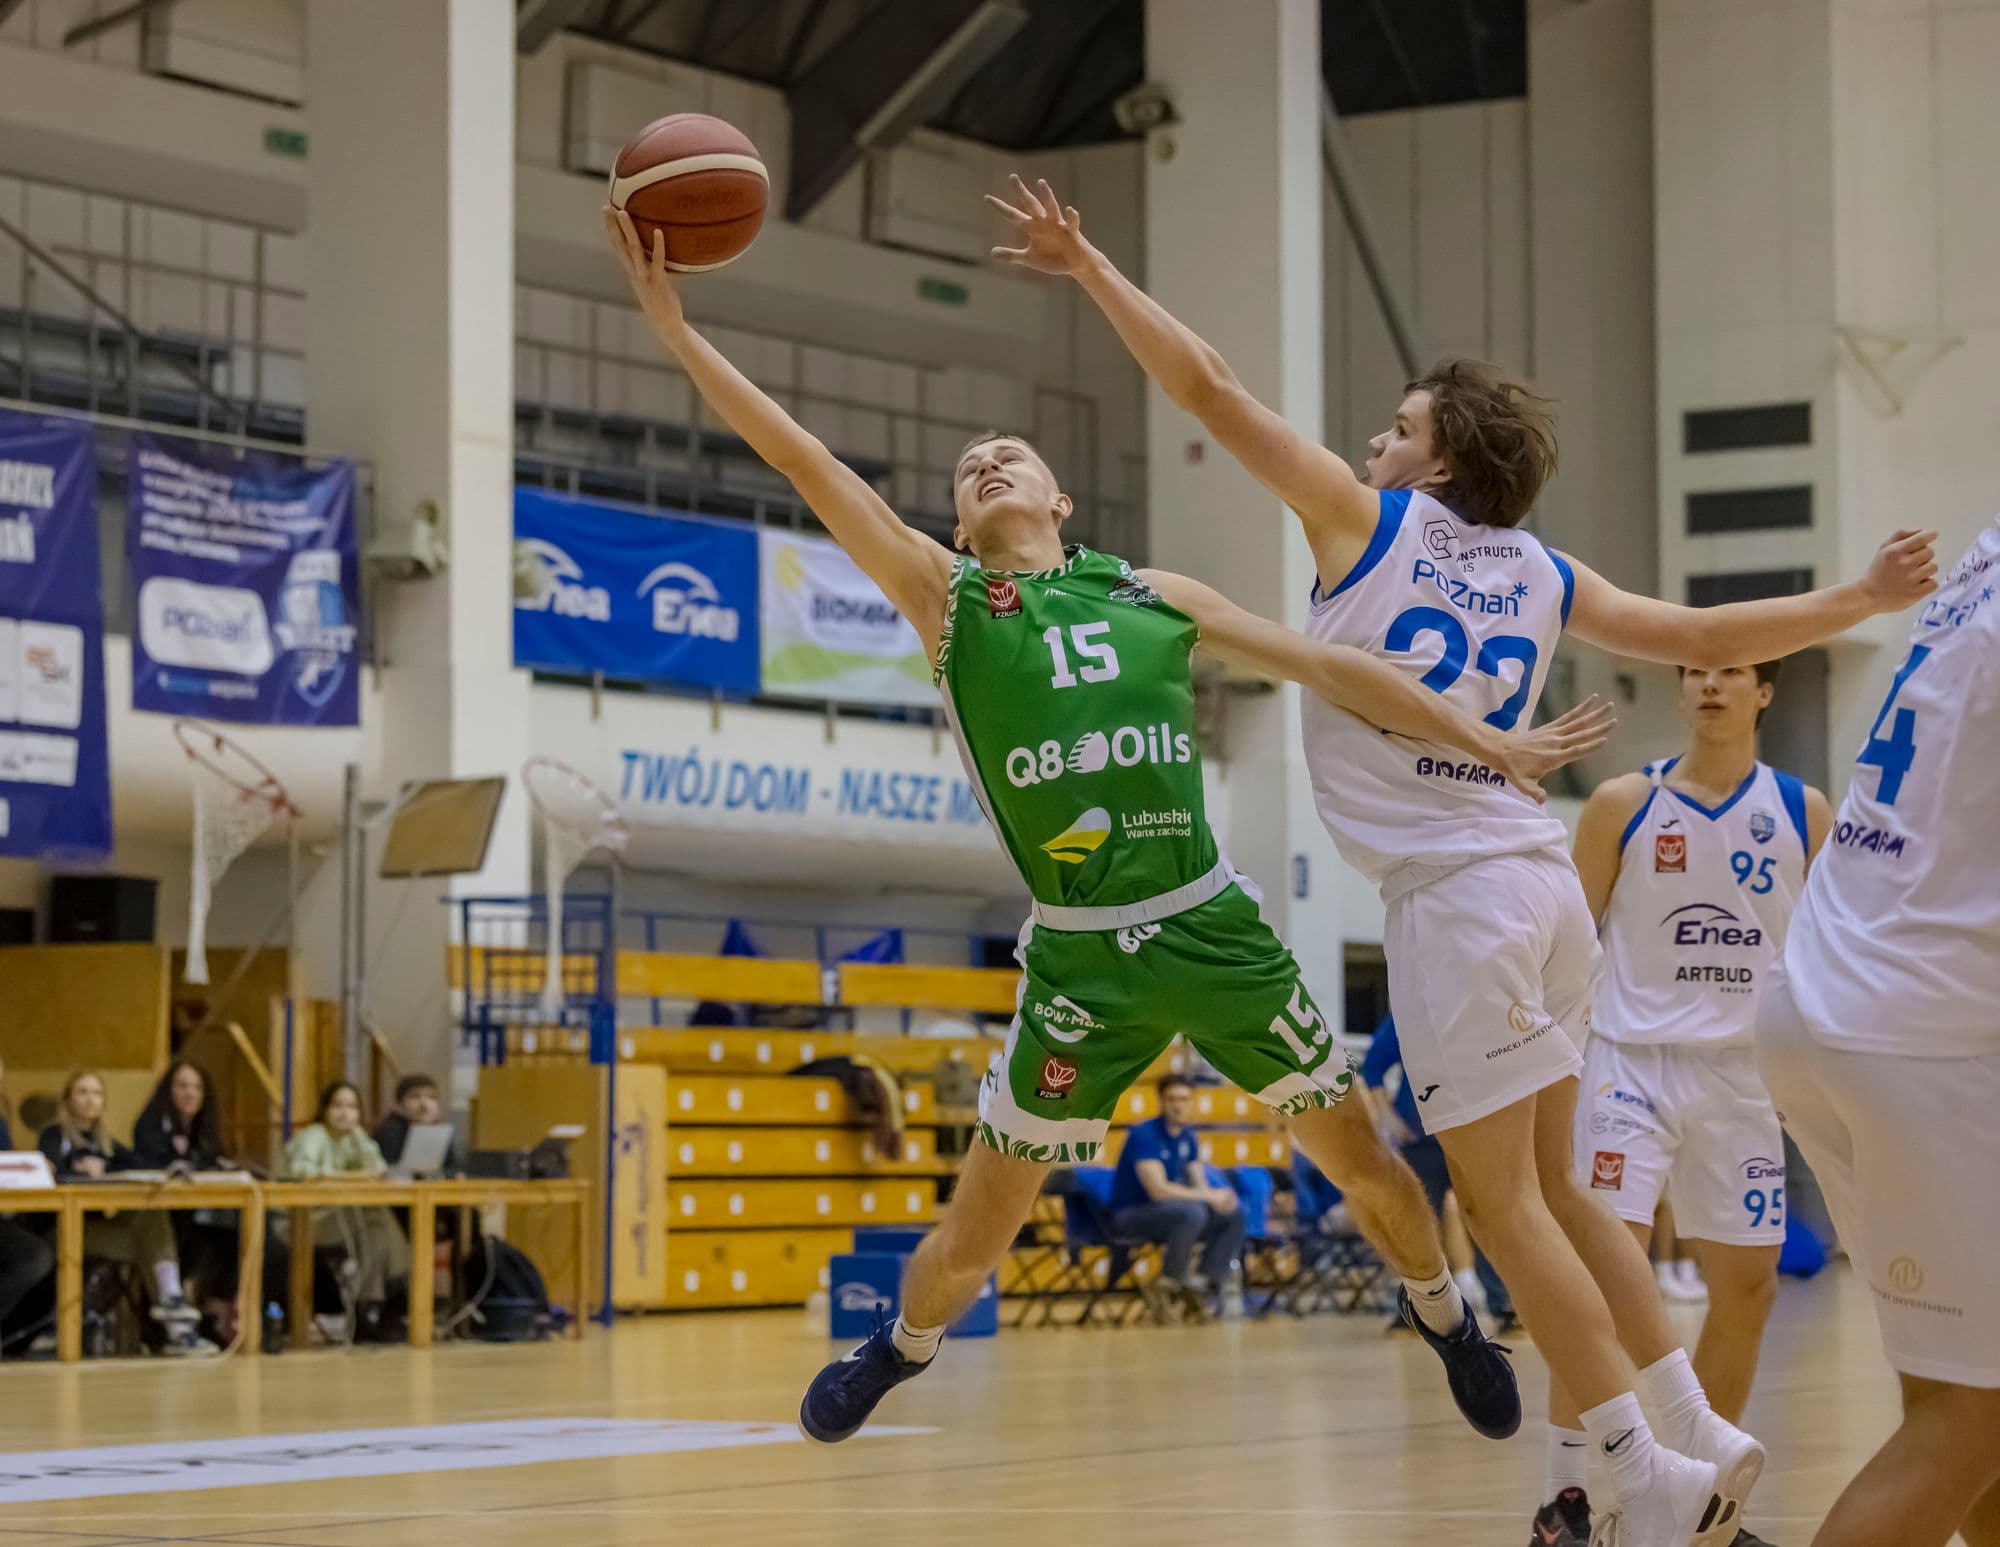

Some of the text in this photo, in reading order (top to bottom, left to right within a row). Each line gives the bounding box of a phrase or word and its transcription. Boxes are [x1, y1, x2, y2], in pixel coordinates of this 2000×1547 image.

[652, 588, 739, 643] Enea
[1042, 621, 1120, 689] 15
[1856, 644, 1932, 806] 4
[1006, 722, 1191, 788] Q8 Oils
[1416, 757, 1506, 787] BIOFARM
[620, 747, 717, 805] TWÓJ
[724, 762, 811, 814] DOM
[838, 768, 939, 821] NASZE
[1126, 828, 1155, 840] Warte
[1730, 850, 1777, 894] 95
[1674, 920, 1762, 946] Enea
[1675, 966, 1753, 983] ARTBUD
[1269, 984, 1328, 1066] 15
[1485, 1041, 1521, 1061] KOPACKI
[1747, 1166, 1785, 1180] Enea
[1743, 1188, 1784, 1227] 95
